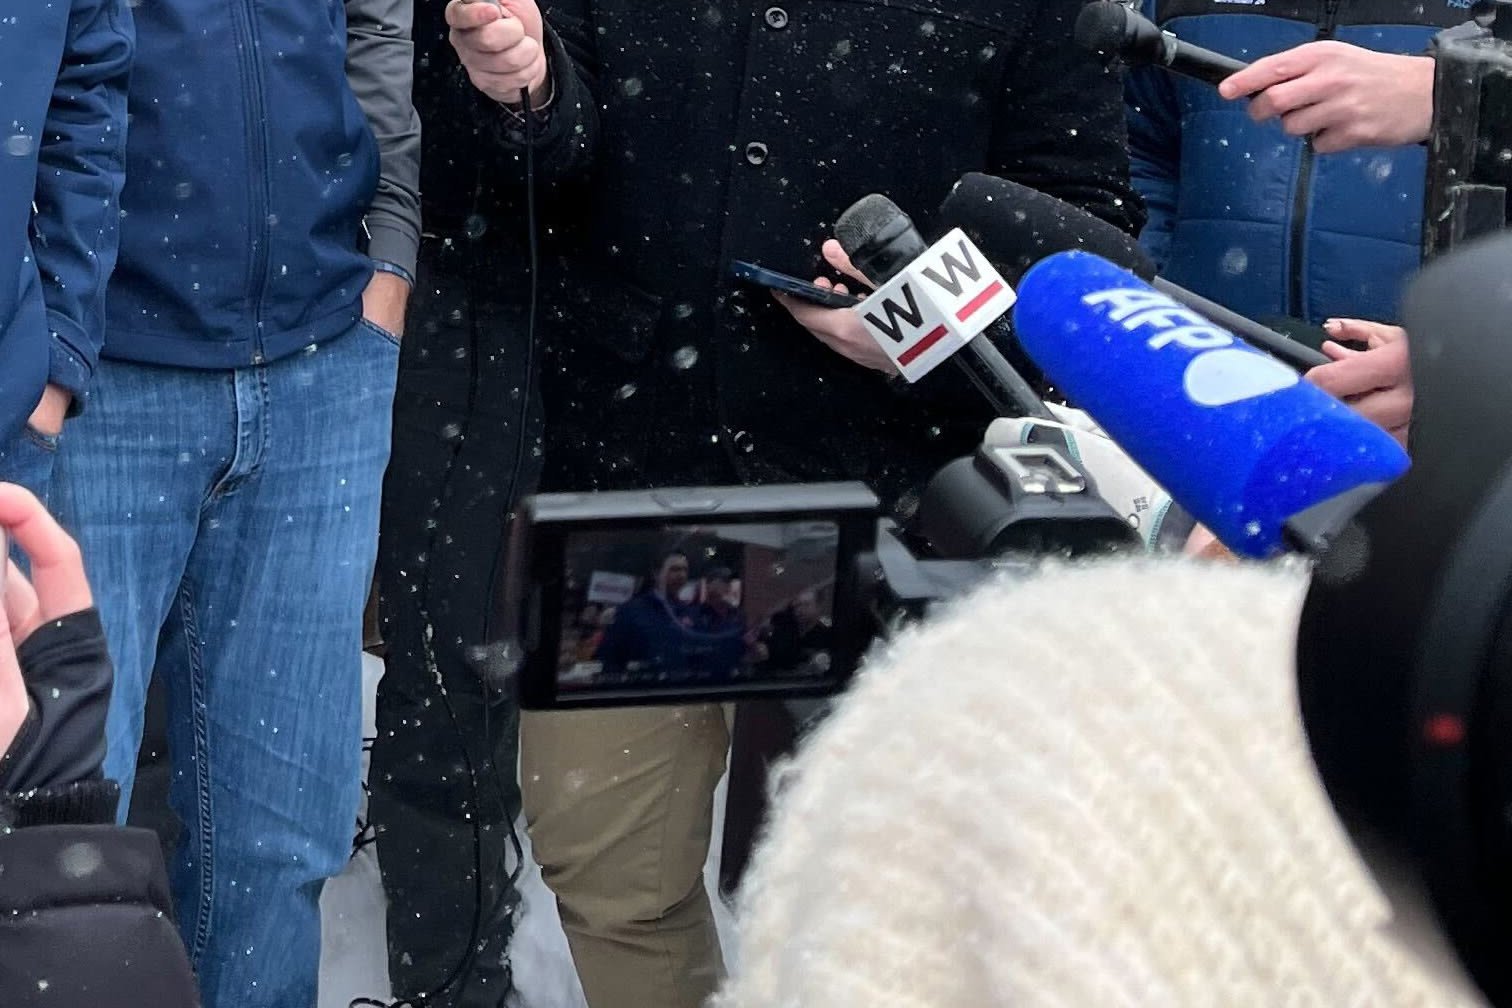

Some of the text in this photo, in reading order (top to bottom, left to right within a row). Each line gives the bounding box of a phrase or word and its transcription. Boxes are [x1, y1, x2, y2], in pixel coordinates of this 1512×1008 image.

[921, 239, 982, 298] W
[864, 282, 925, 343] W
[1082, 289, 1234, 350] AFP
